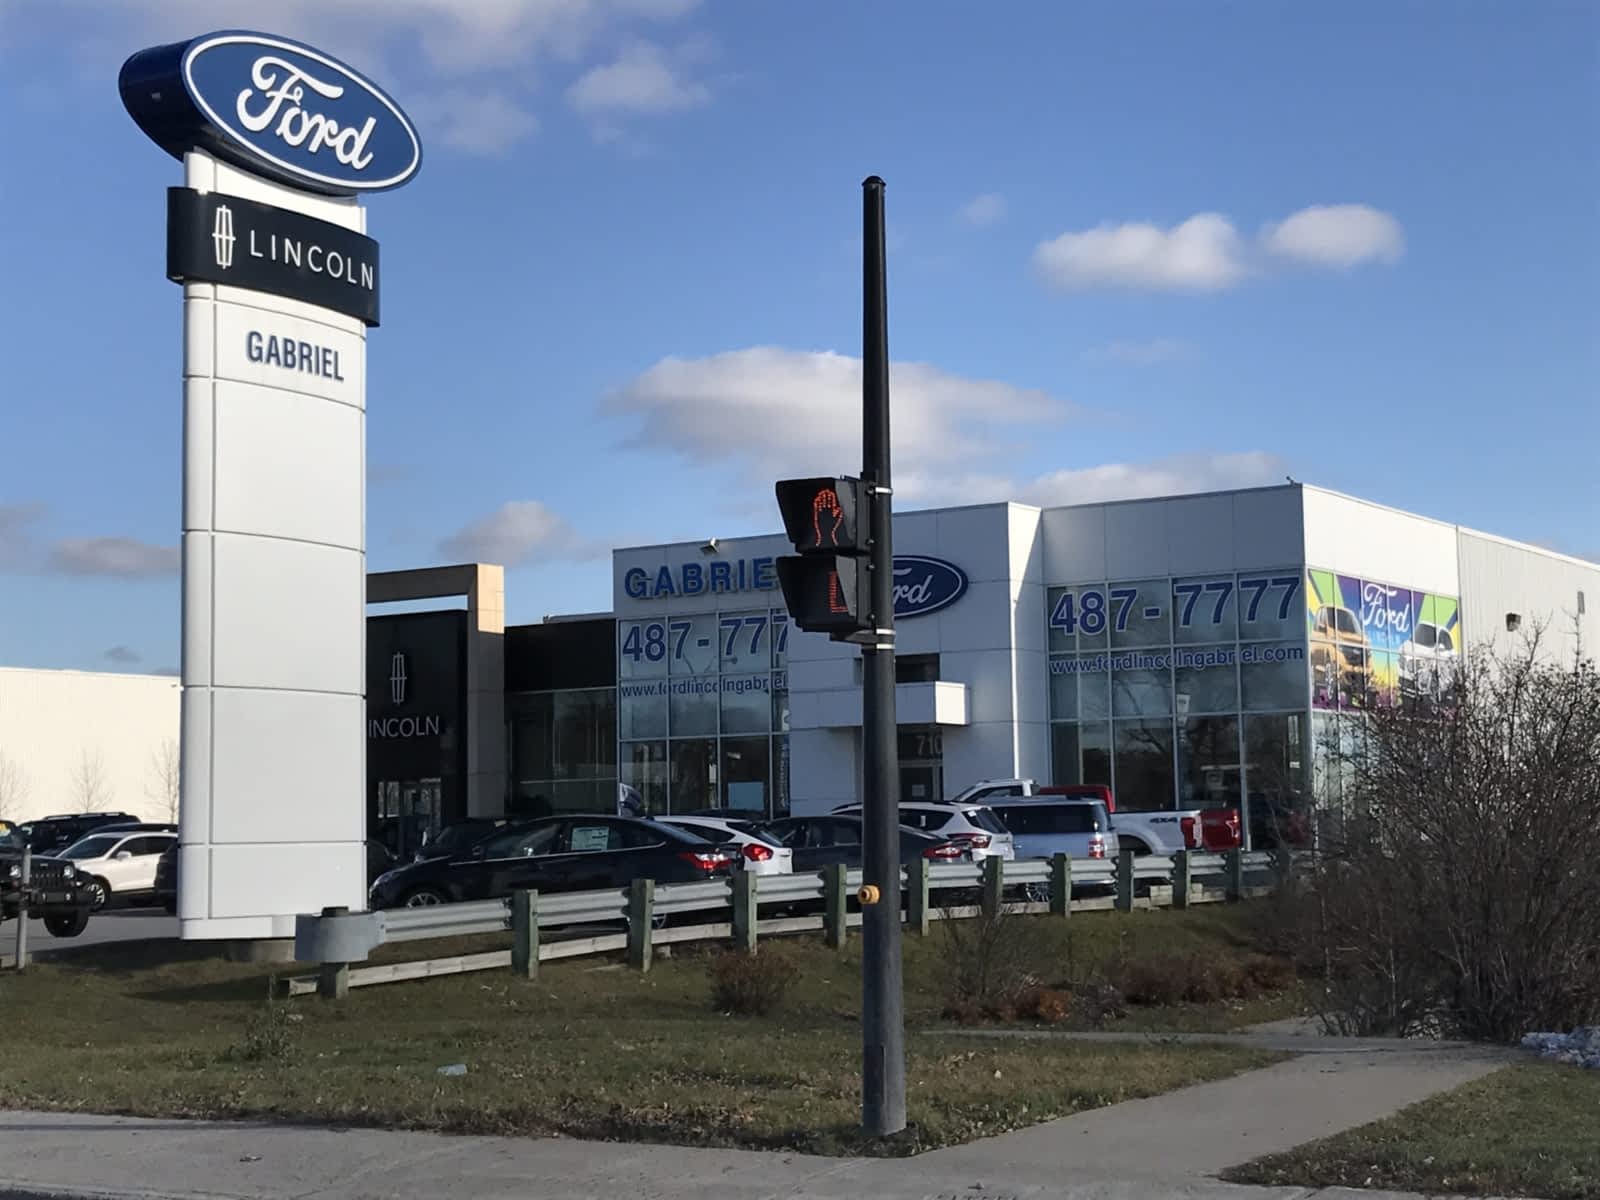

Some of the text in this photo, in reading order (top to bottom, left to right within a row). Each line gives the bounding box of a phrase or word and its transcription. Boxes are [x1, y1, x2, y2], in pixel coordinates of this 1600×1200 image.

[236, 55, 378, 170] Ford
[249, 229, 375, 291] LINCOLN
[246, 330, 345, 382] GABRIEL
[624, 557, 776, 599] GABRIE
[1049, 576, 1300, 637] 487-7777
[1359, 583, 1411, 633] Ford
[621, 614, 788, 663] 487-777
[1050, 645, 1304, 674] www.fordlincolngabrel.com
[367, 714, 440, 739] INCOLN
